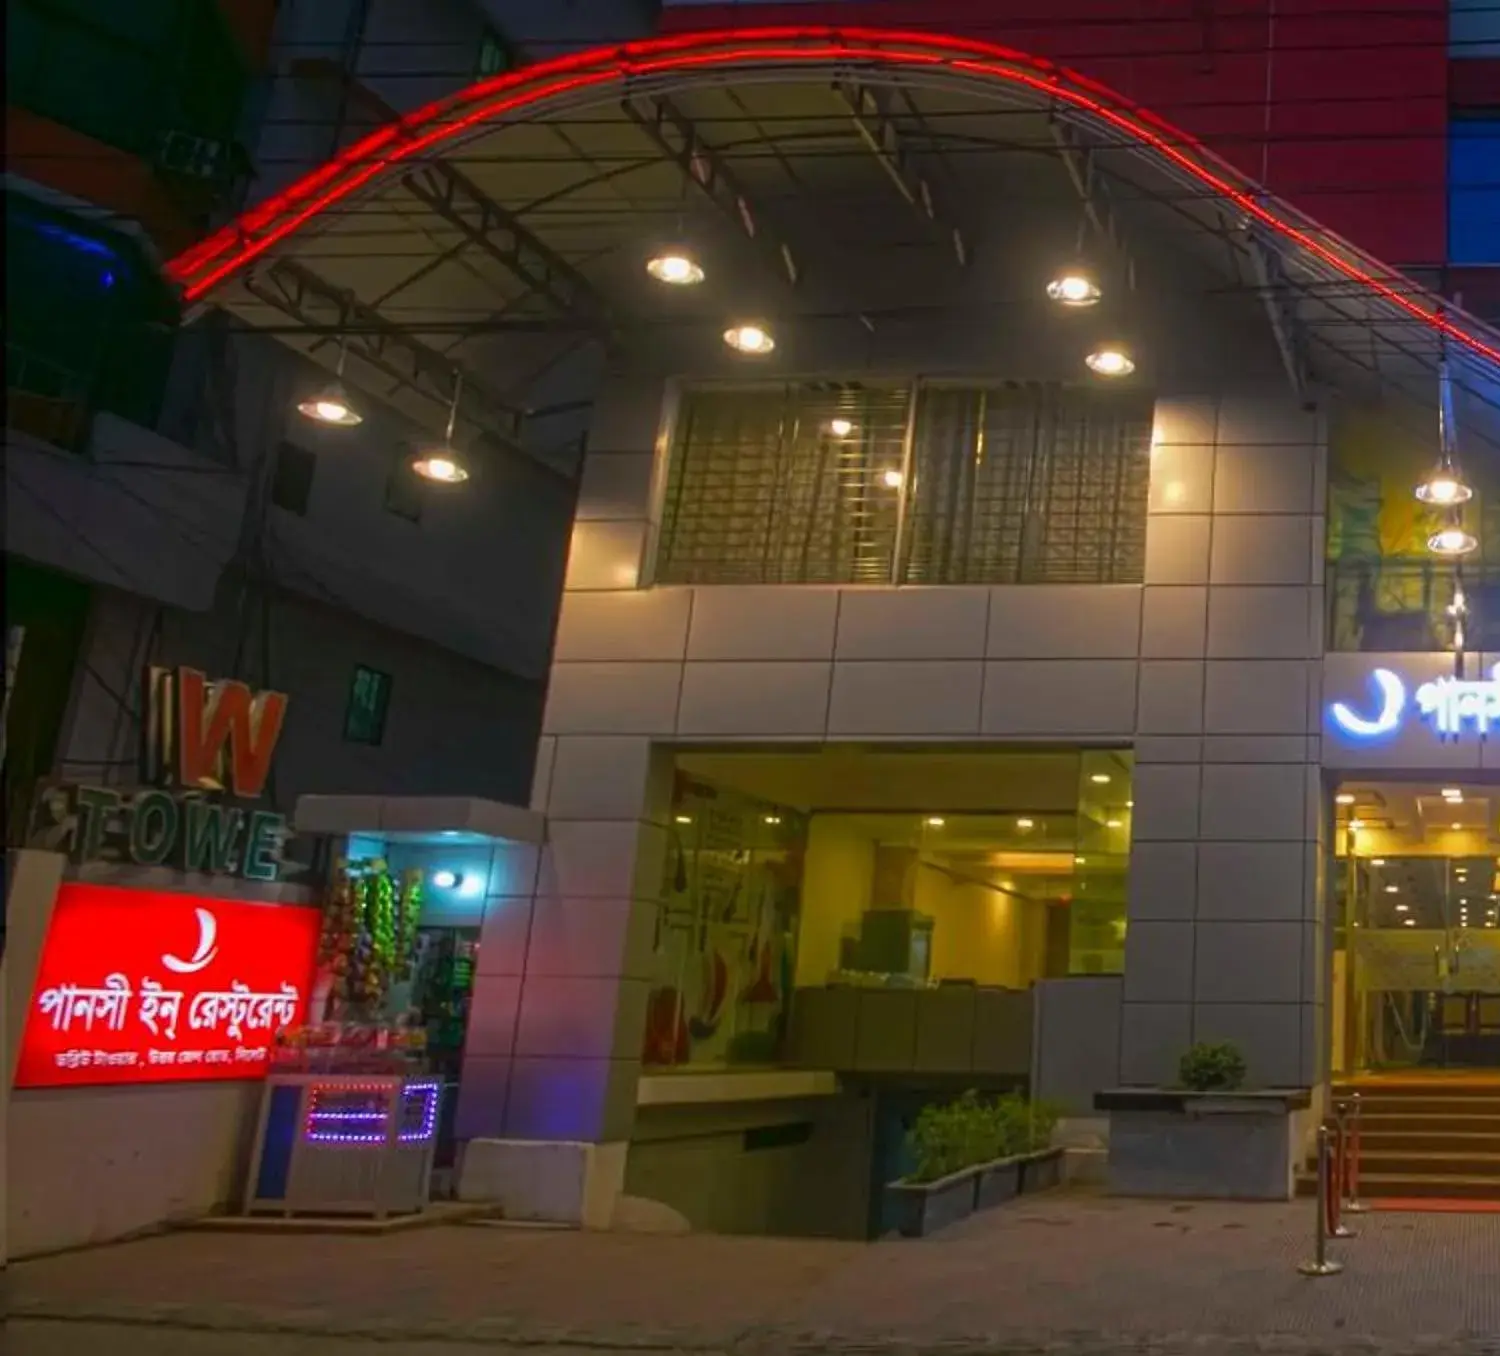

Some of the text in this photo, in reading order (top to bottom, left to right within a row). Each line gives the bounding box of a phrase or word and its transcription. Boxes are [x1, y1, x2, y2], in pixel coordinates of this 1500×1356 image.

[39, 973, 299, 1041] পানসী ইন্ রেস্টুরেন্ট
